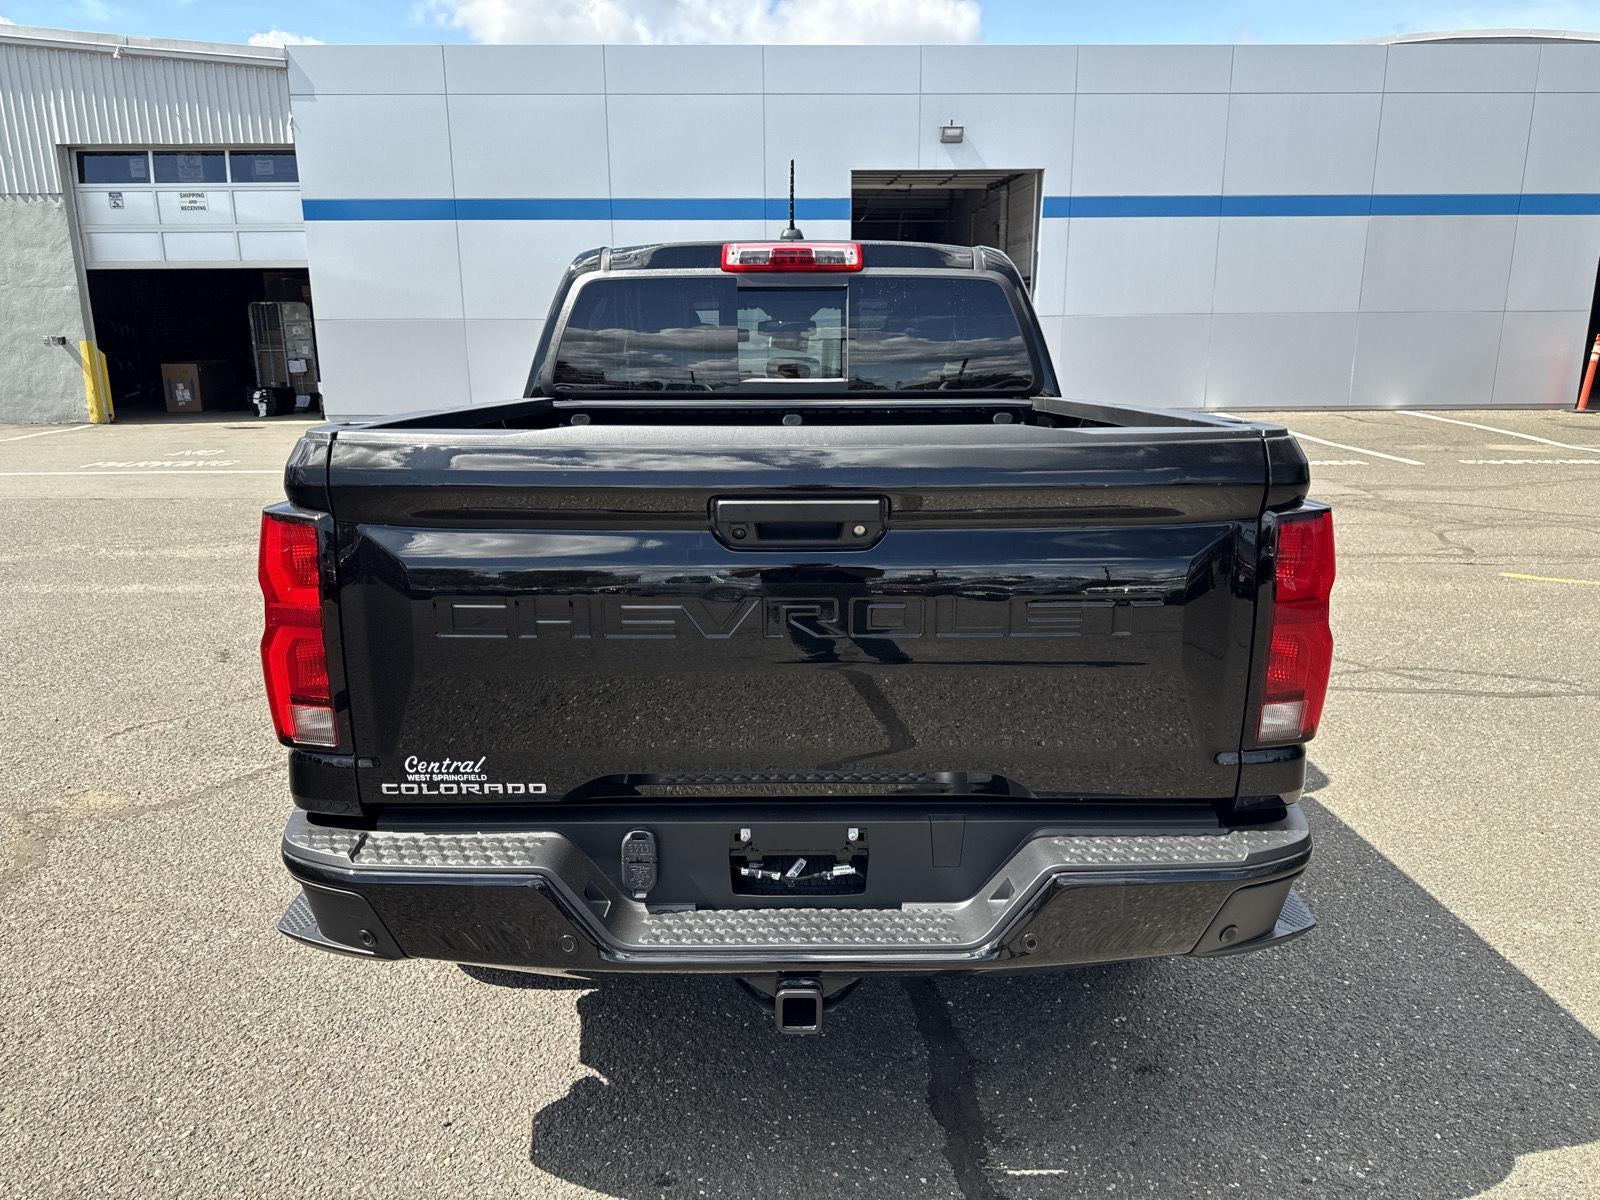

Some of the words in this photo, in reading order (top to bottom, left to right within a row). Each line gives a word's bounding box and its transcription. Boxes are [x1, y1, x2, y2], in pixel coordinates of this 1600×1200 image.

[433, 596, 1165, 640] CHEVROLET
[404, 755, 486, 773] Central
[381, 782, 547, 795] COLORADO
